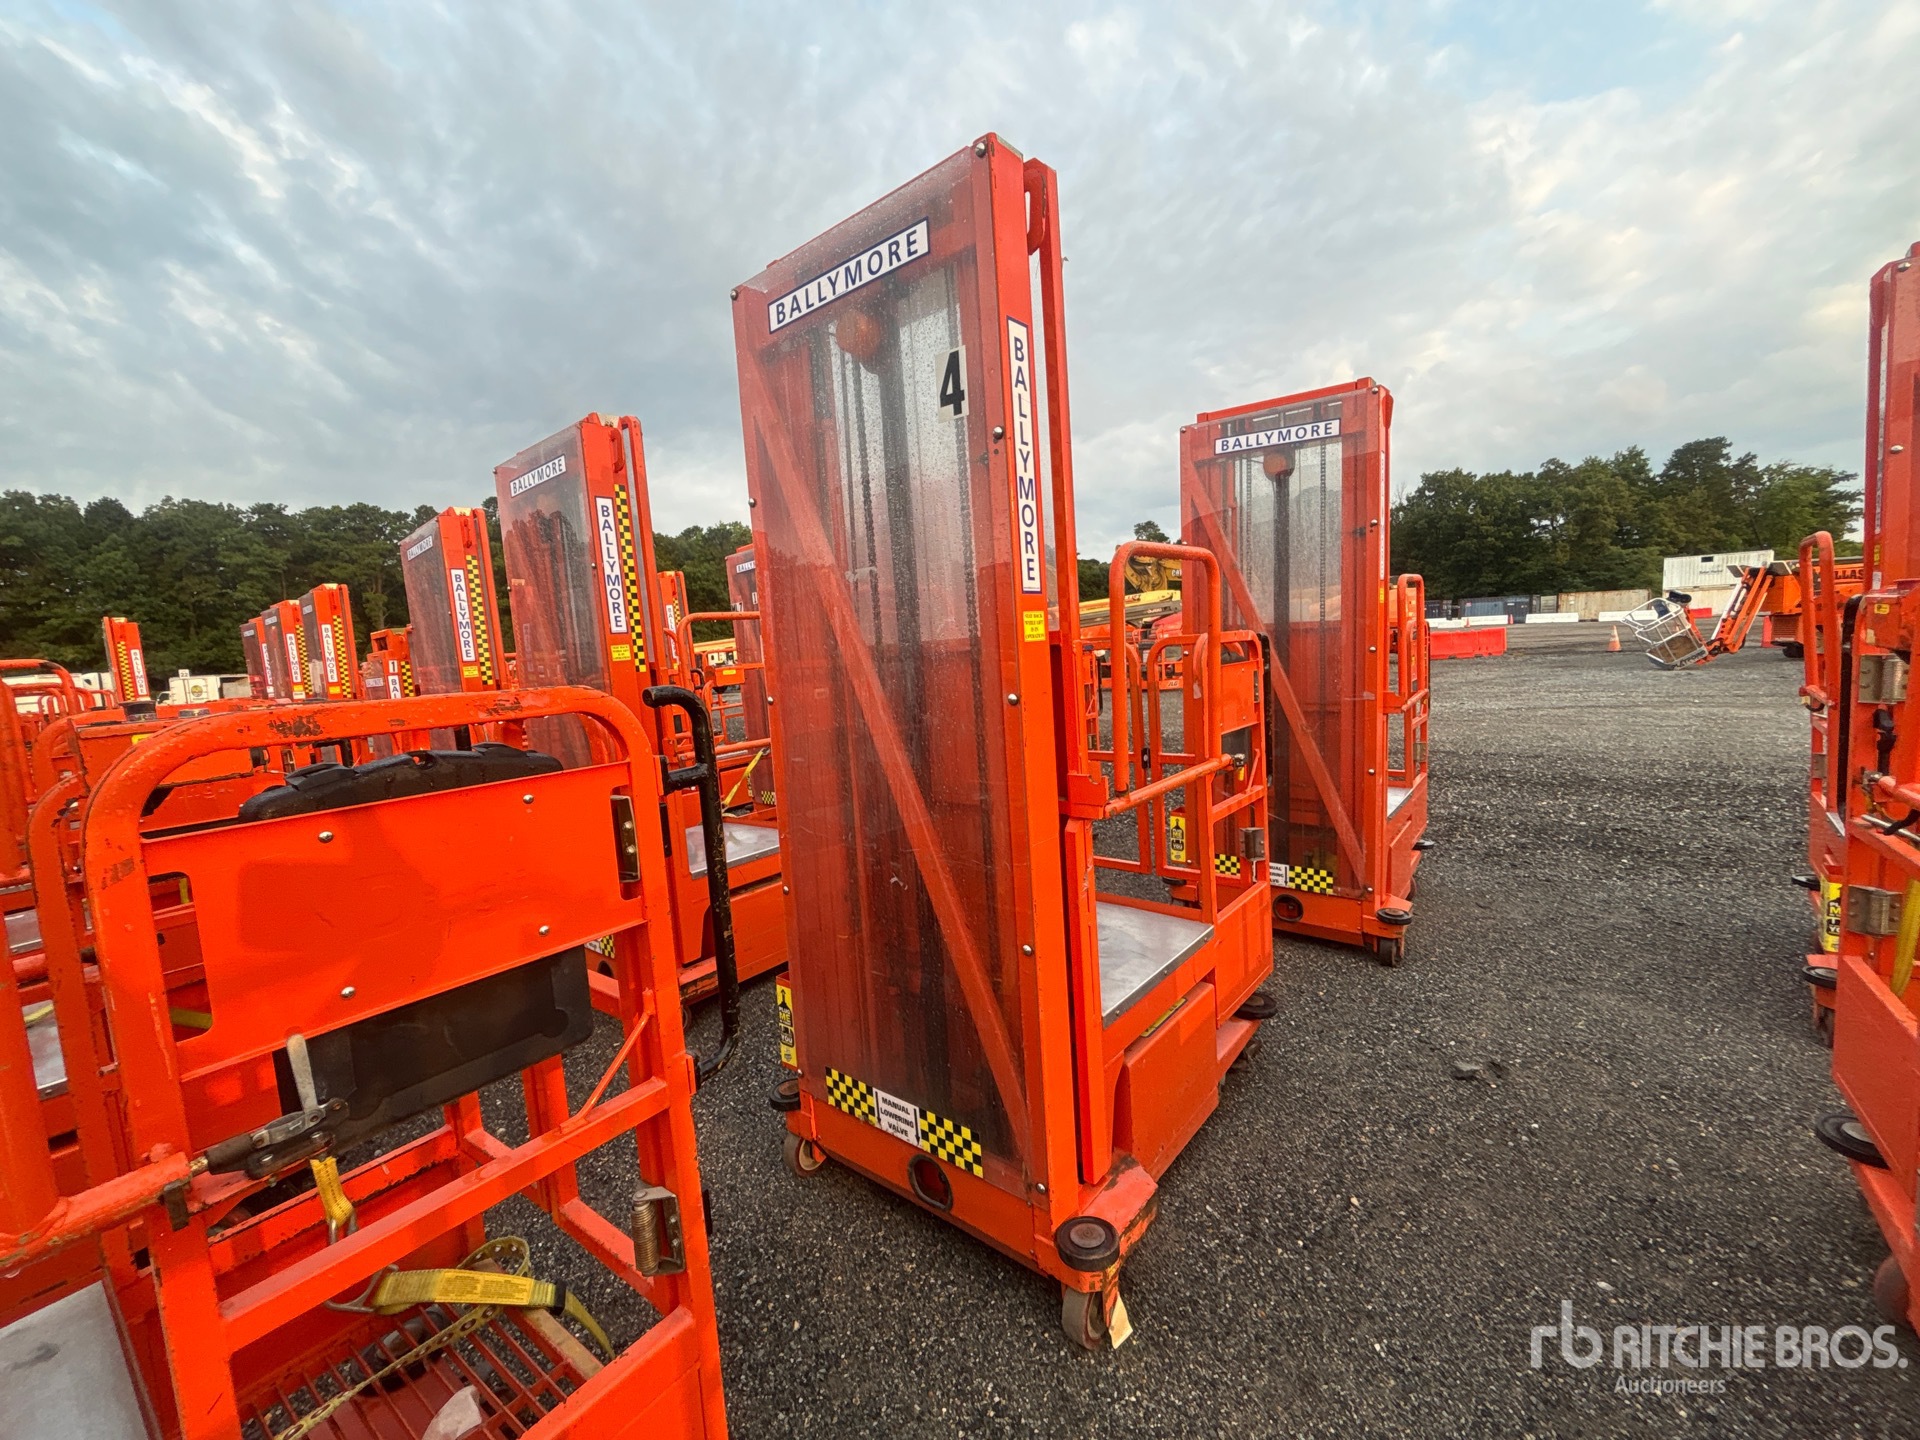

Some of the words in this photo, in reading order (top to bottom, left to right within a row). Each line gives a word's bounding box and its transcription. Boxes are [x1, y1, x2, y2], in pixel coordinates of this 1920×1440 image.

[776, 228, 919, 325] BALLYMORE
[939, 350, 966, 416] 4
[1220, 421, 1334, 452] BALLYMORE
[511, 458, 564, 495] BALLYMORE
[1013, 337, 1036, 582] BALLYMORE
[600, 504, 623, 628] BALLYMORE
[454, 574, 473, 659] BALLYMORE
[133, 651, 144, 694] BALLYMORE
[288, 635, 300, 681] BALLYMORE
[324, 627, 335, 681] BALLYMORE
[390, 660, 397, 673] 1
[779, 1012, 791, 1021] ME
[781, 1034, 793, 1043] YOU
[880, 1107, 914, 1129] LOWERING
[881, 1096, 911, 1115] MANUAL
[887, 1121, 909, 1137] VALVE
